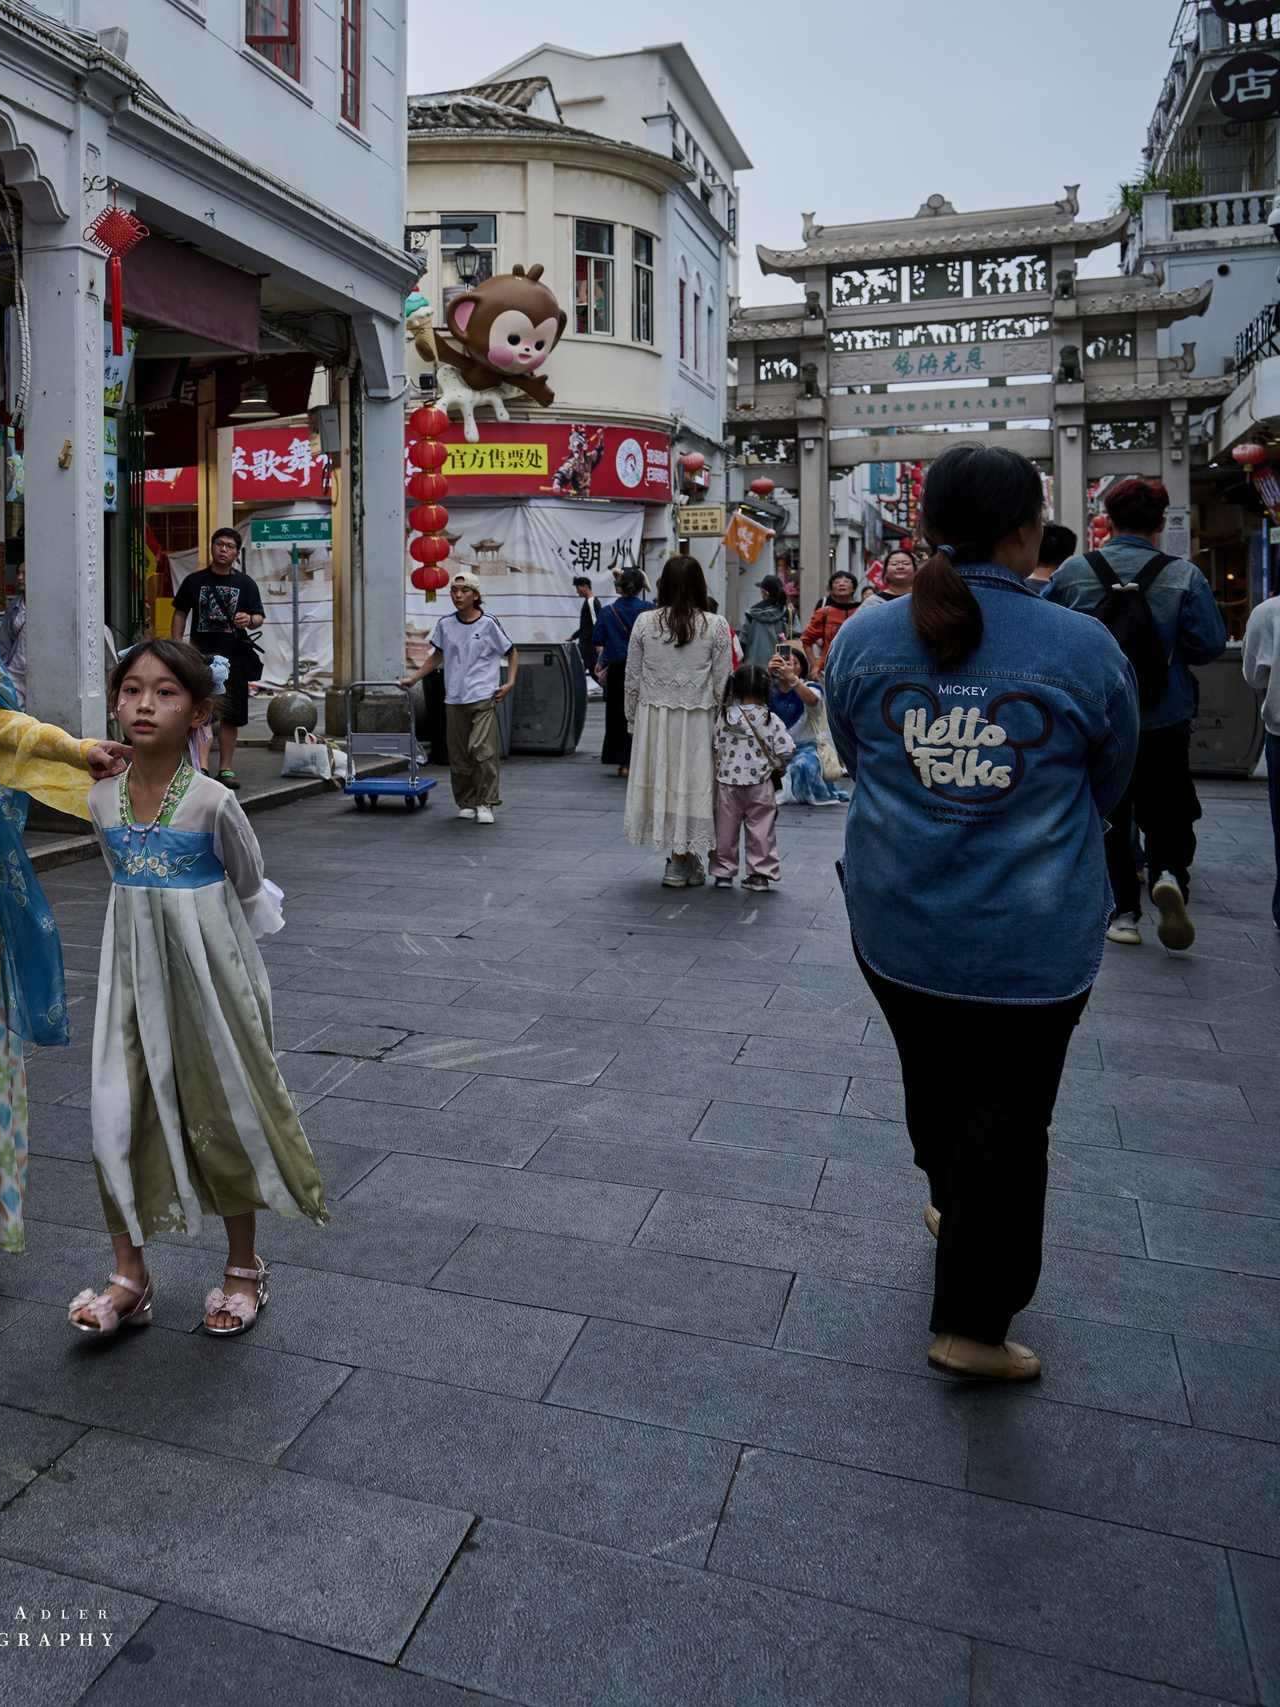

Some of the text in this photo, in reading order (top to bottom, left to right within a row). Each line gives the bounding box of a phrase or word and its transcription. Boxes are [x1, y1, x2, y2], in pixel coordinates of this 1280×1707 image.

[1220, 67, 1279, 103] 店
[448, 448, 542, 469] 官方售票处
[261, 521, 330, 534] 上东平路
[568, 537, 637, 572] 潮州
[938, 684, 988, 698] MICKEY
[903, 706, 1007, 753] Hello
[911, 747, 1012, 789] Folks
